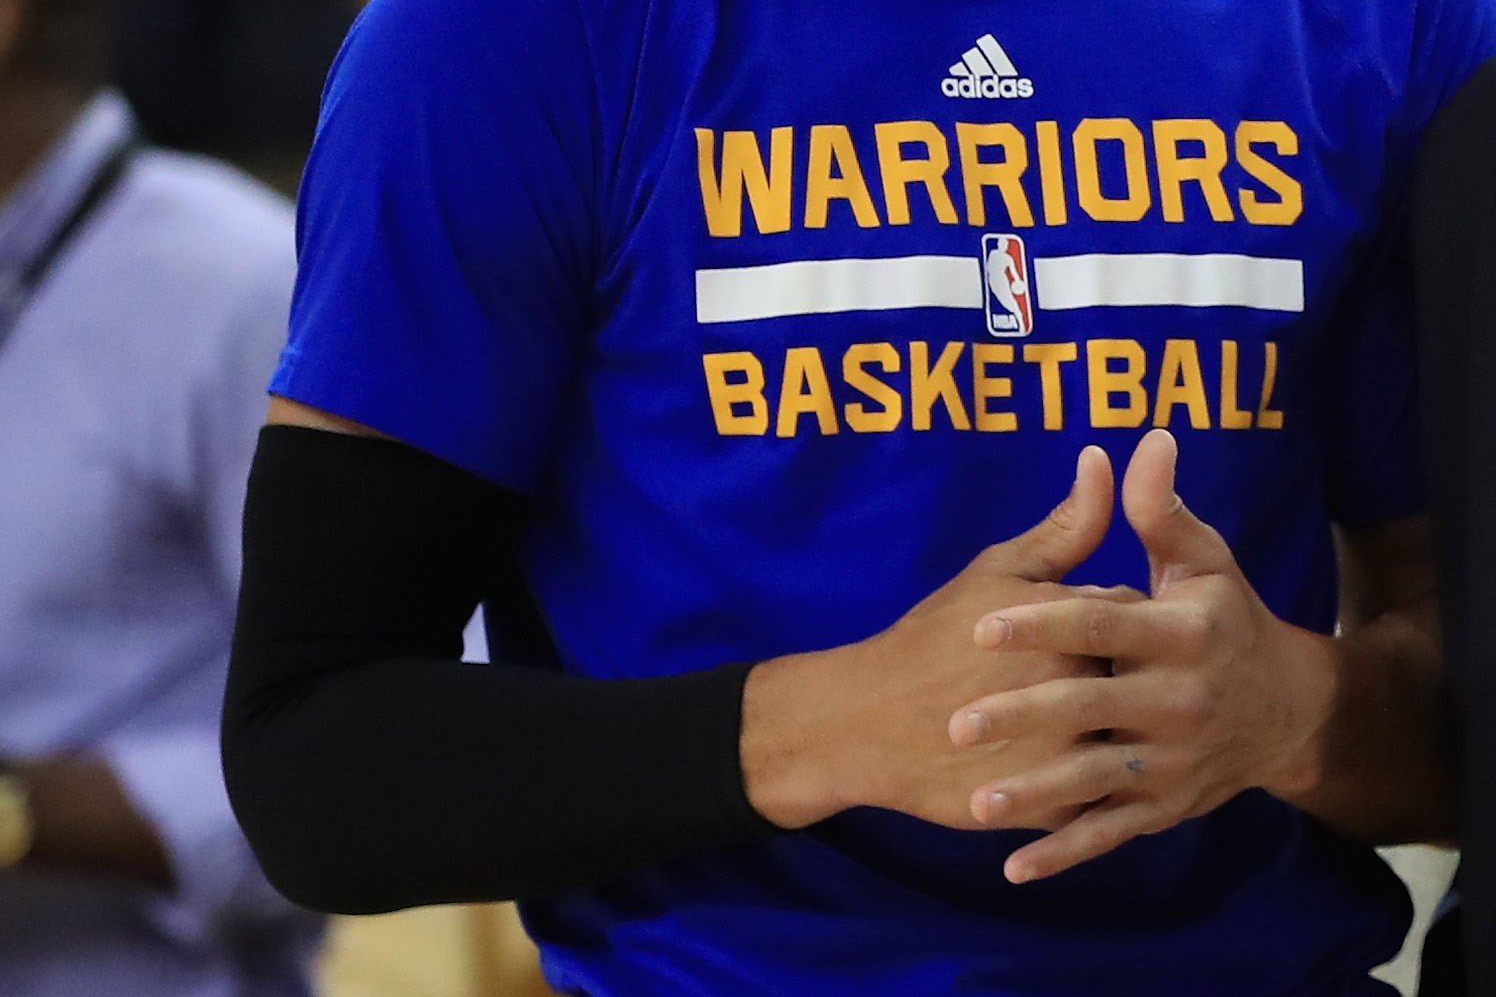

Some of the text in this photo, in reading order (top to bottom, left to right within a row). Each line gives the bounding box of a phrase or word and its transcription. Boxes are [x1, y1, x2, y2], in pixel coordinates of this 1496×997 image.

[941, 74, 1034, 99] adidas
[695, 118, 1303, 238] WARRIORS
[703, 339, 1284, 438] BASKETBALL
